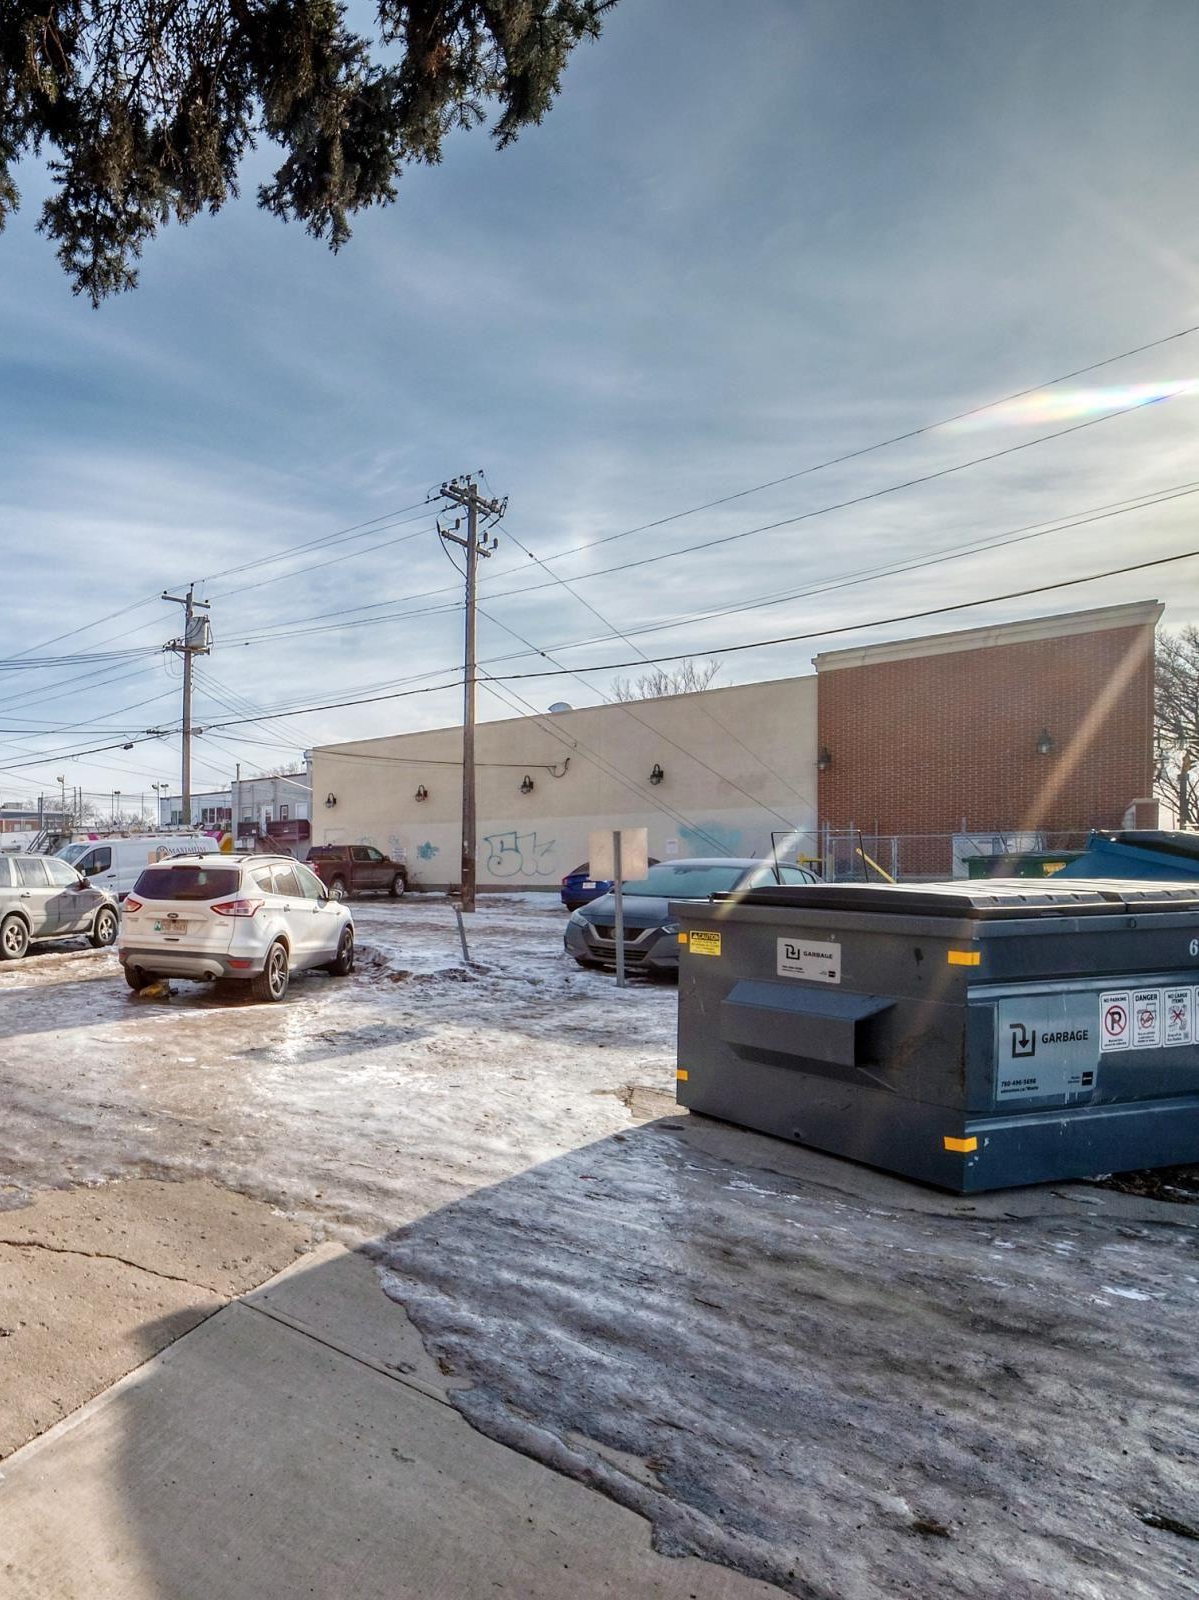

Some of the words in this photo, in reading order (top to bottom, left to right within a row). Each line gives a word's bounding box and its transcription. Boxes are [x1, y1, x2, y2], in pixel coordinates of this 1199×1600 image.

[803, 951, 833, 960] GARBAGE
[1135, 993, 1158, 1002] DANGER
[1041, 1030, 1089, 1044] GARBAGE
